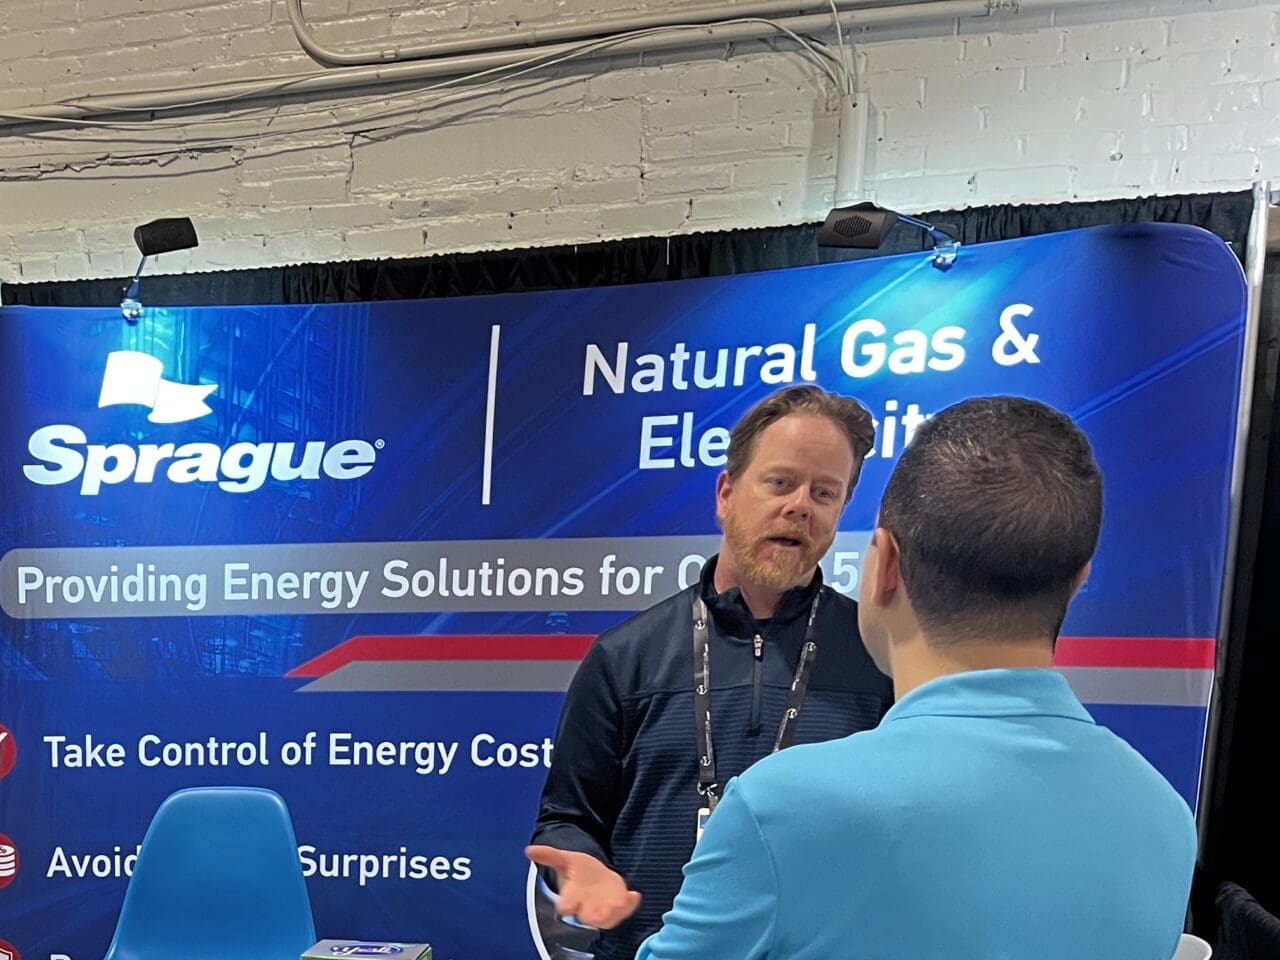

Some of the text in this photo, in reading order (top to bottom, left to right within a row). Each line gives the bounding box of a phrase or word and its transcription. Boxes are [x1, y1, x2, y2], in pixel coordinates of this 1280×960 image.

[583, 303, 1041, 397] Natural Gas &
[18, 564, 208, 611] Providing
[223, 562, 369, 609] Energy
[380, 556, 585, 601] Solutions
[599, 553, 664, 594] for
[43, 735, 126, 769] Take
[137, 732, 269, 768] Control
[280, 731, 317, 767] of
[328, 732, 454, 775] Energy
[297, 844, 472, 887] Surprises
